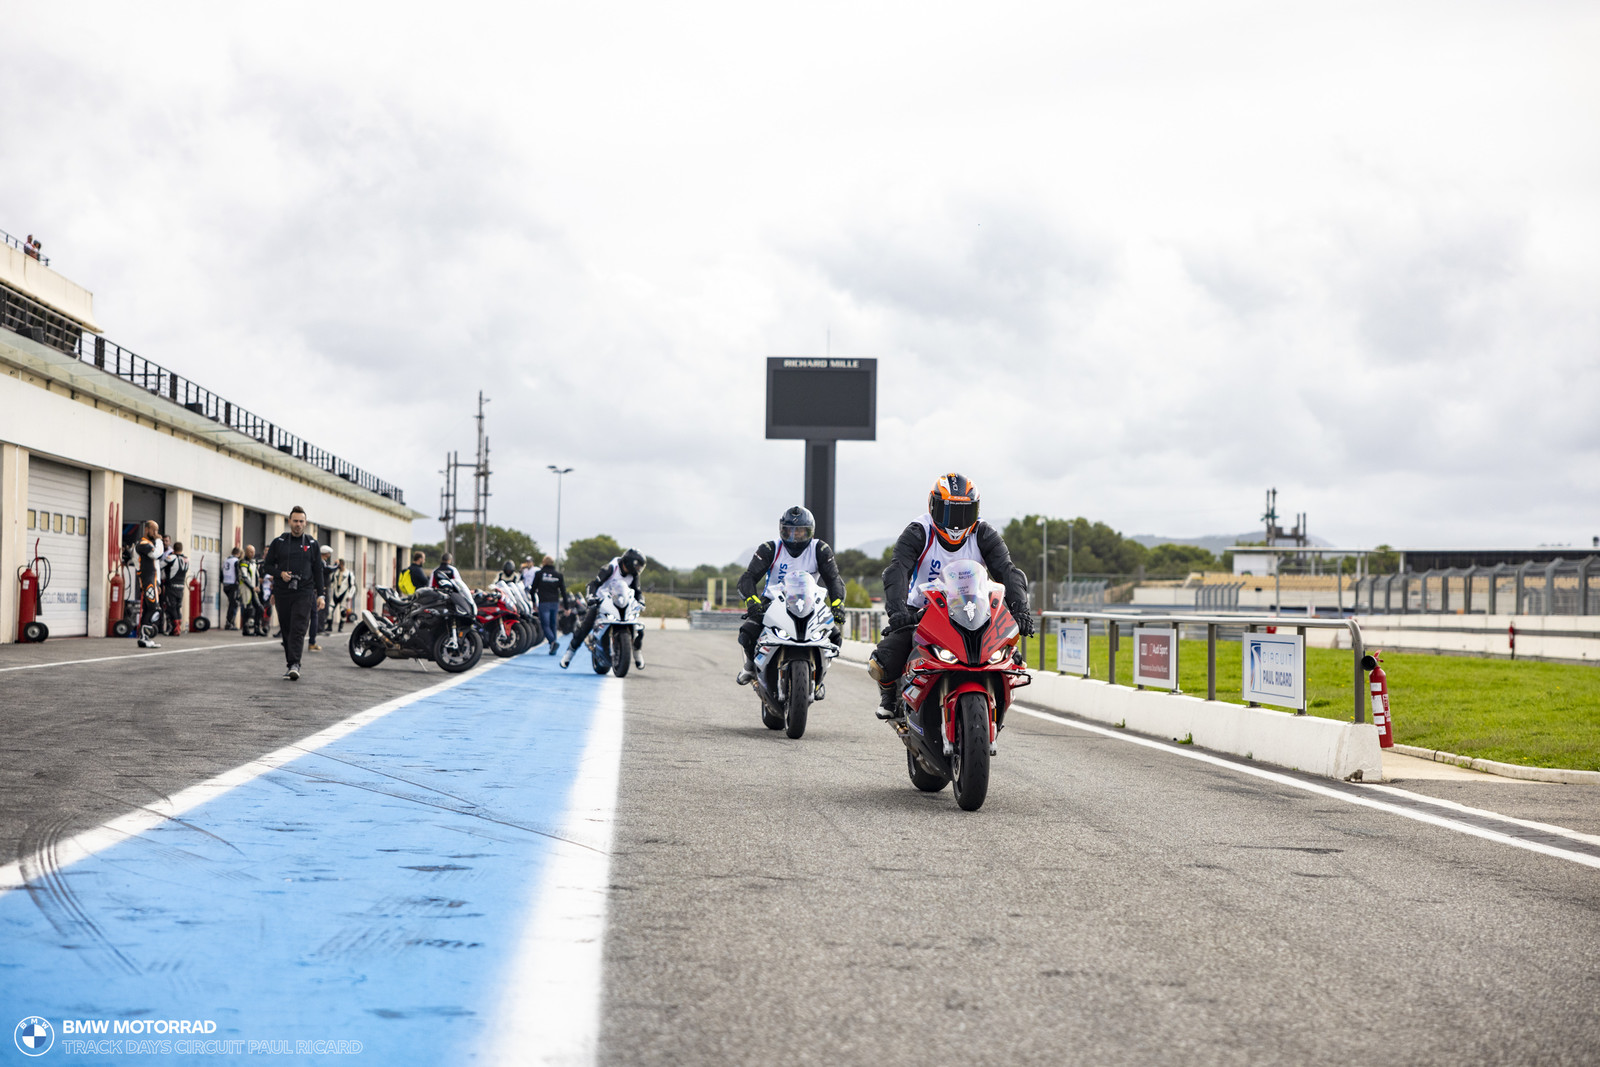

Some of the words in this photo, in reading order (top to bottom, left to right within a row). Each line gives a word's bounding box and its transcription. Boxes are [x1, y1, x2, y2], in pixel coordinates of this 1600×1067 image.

[783, 359, 828, 368] RICHARD
[830, 360, 859, 369] MILLE
[1262, 651, 1293, 665] CIRCUIT
[1263, 670, 1275, 685] PAUL
[1275, 671, 1293, 687] RICARD
